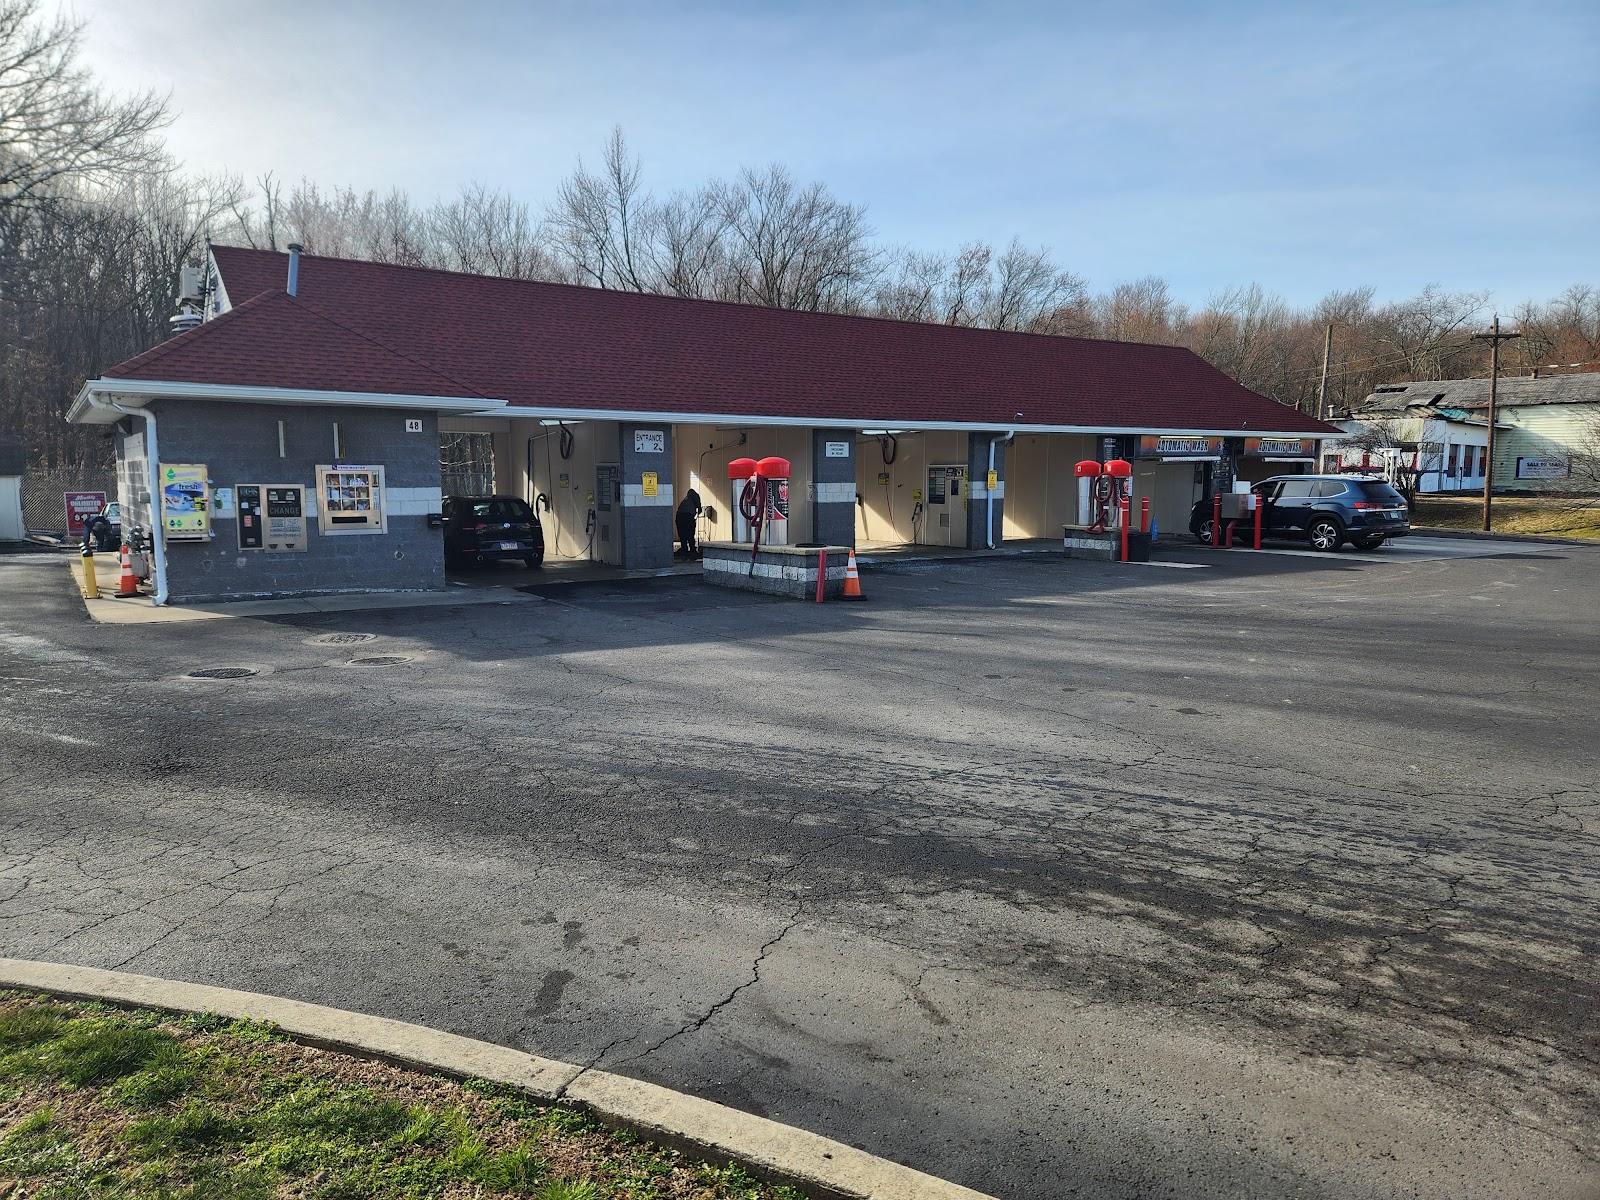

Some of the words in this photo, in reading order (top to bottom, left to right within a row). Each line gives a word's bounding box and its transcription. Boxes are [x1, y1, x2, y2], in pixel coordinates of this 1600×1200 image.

[409, 421, 419, 430] 48
[636, 433, 662, 442] ENTRANCE
[1156, 440, 1190, 452] AUTOMATIC
[1191, 440, 1209, 452] WASH
[1258, 441, 1286, 453] AUTOMATIC
[1287, 442, 1302, 453] WASH
[269, 506, 300, 514] CHANGE
